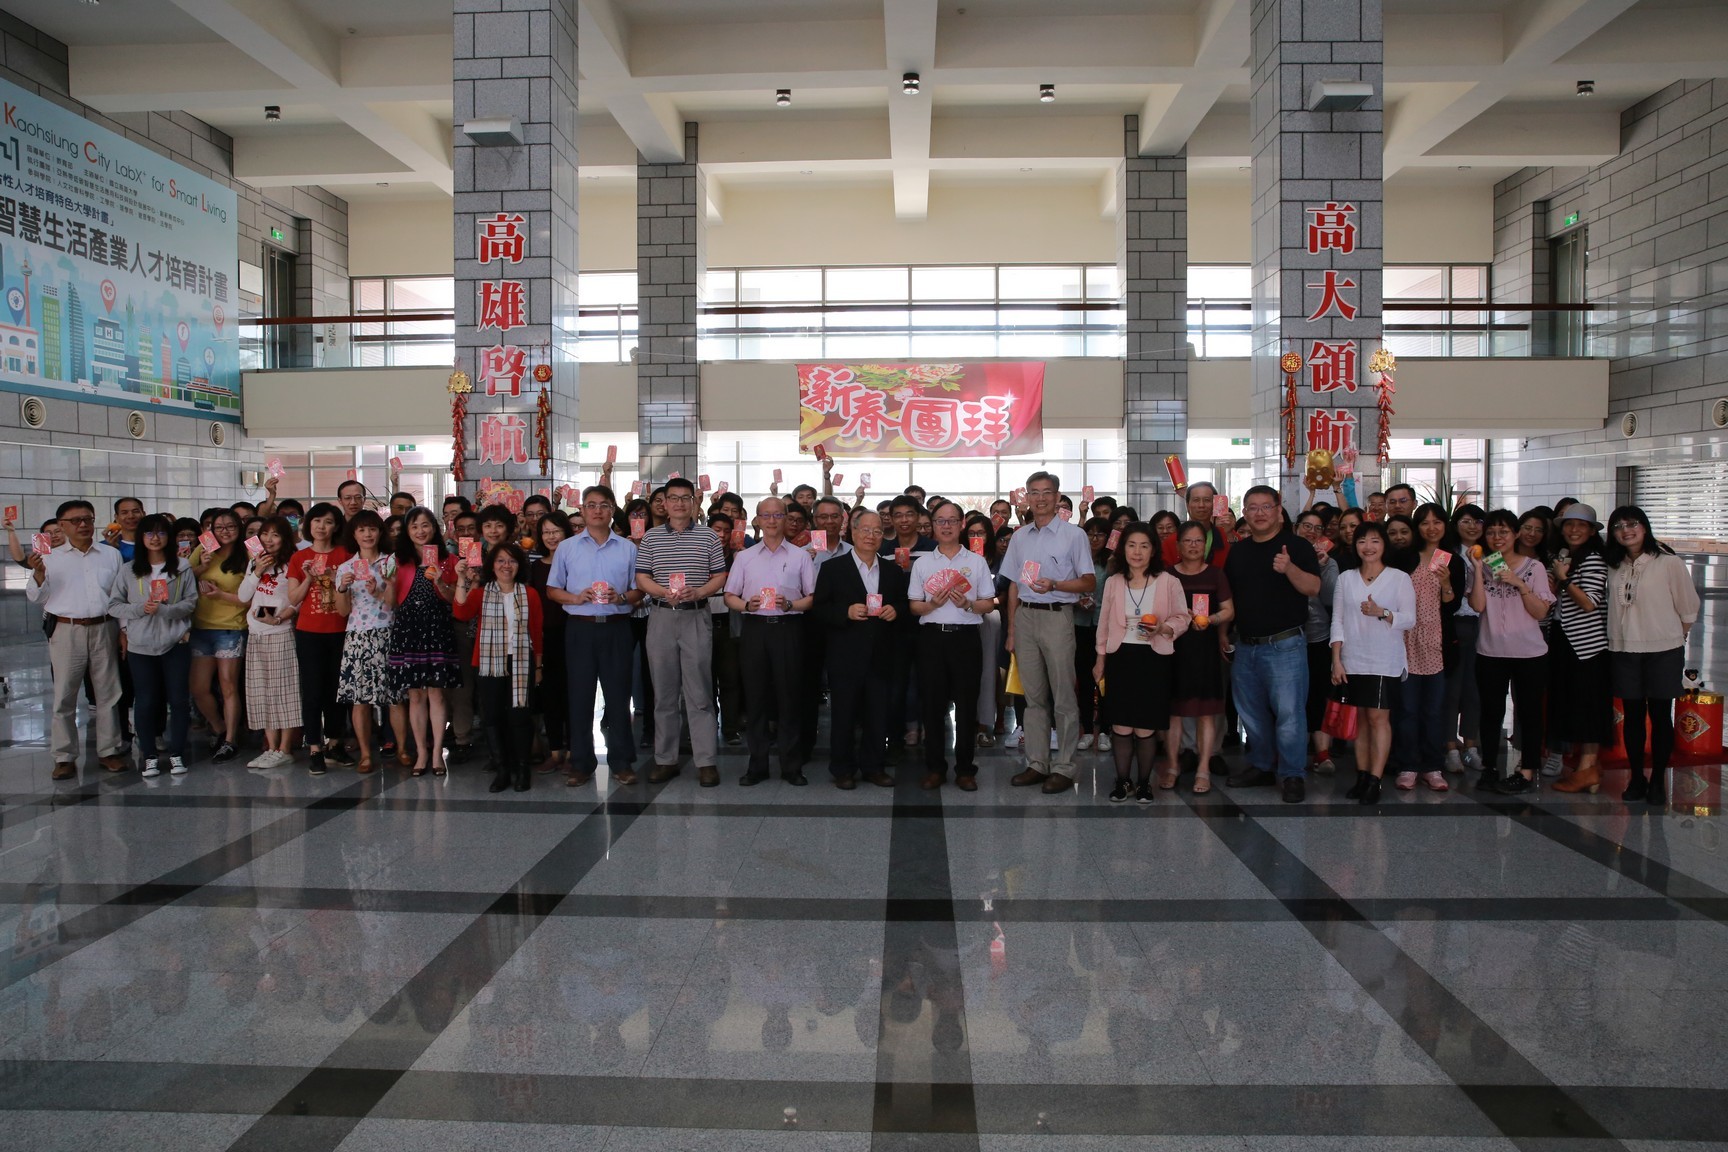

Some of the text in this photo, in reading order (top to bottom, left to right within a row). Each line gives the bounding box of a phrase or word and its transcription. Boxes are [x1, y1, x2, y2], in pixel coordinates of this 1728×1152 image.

[4, 102, 79, 159] Kaohsiung
[84, 141, 110, 172] City
[152, 176, 165, 193] for
[169, 179, 198, 208] Smart
[201, 193, 227, 223] Living
[801, 367, 1012, 451] 新春團拜
